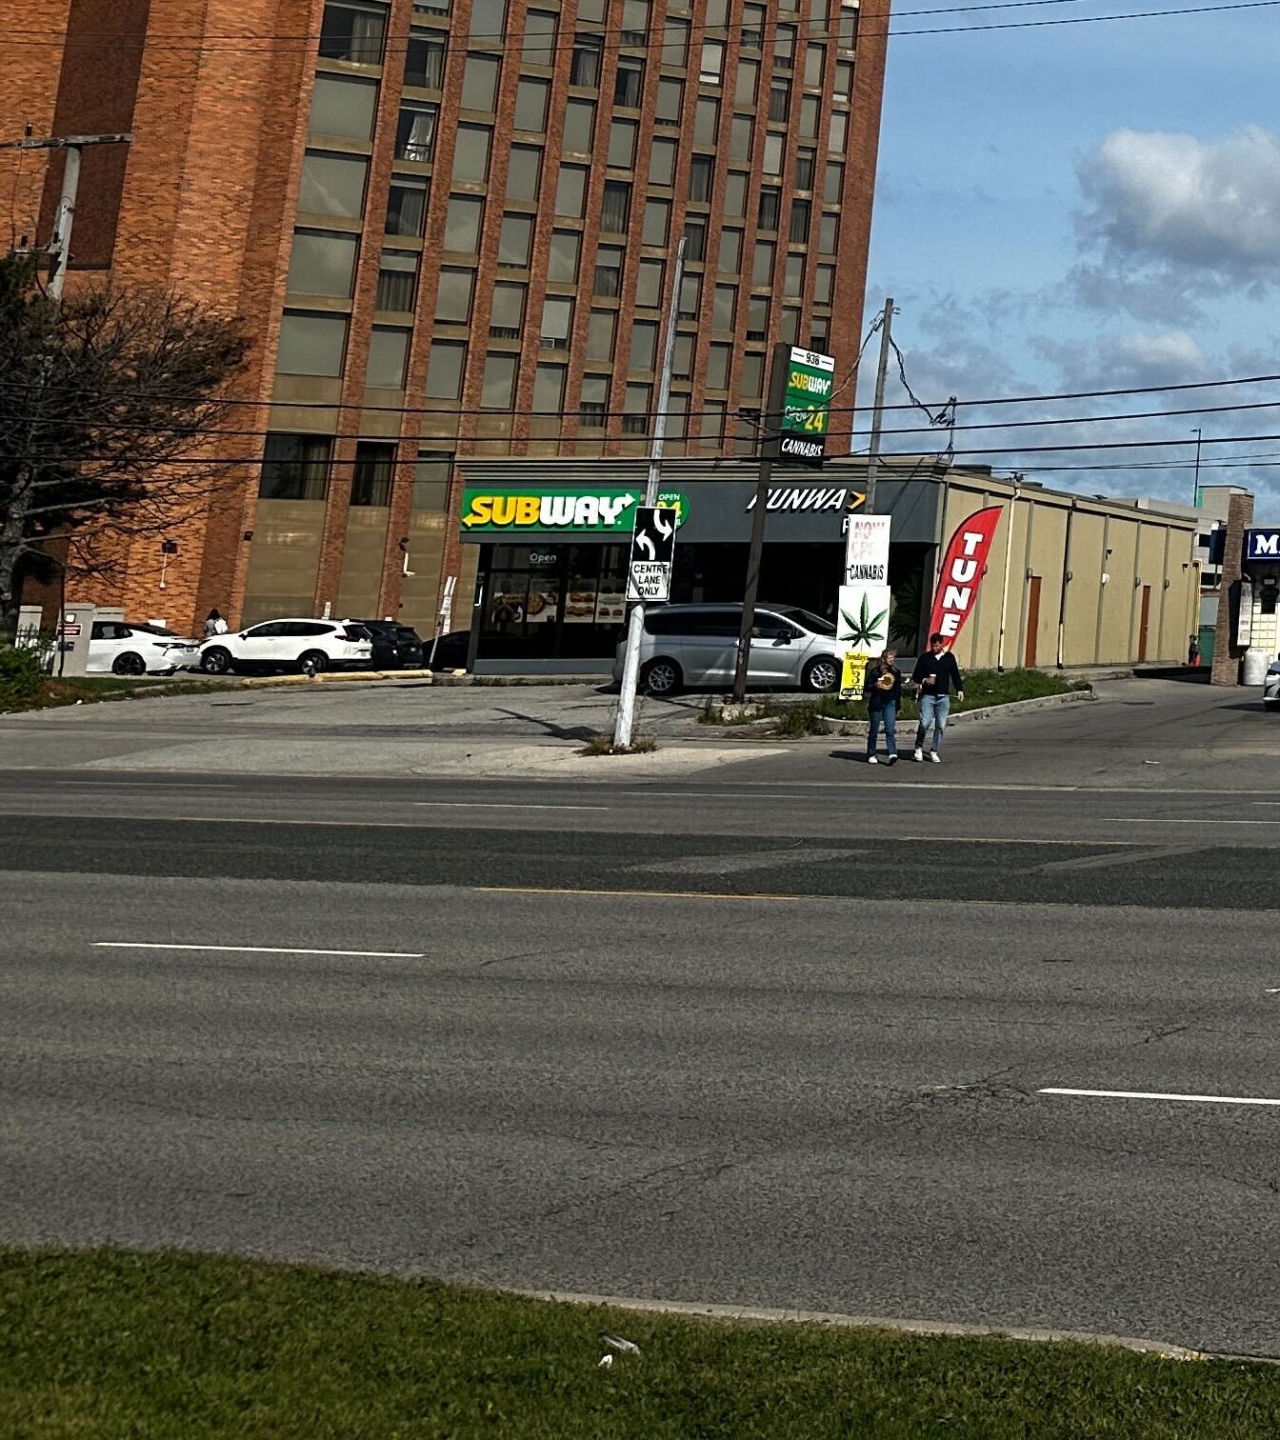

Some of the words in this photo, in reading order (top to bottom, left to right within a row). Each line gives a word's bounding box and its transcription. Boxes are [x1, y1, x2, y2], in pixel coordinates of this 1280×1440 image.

[788, 371, 831, 396] SUBWAY
[804, 404, 828, 433] 24
[781, 438, 823, 457] CANNABIS
[658, 493, 680, 501] OPEN
[462, 493, 636, 527] SUBWAY
[529, 552, 557, 563] Open
[633, 564, 668, 574] CENTRE
[850, 564, 884, 580] CANNABIS
[638, 575, 661, 585] LANE
[939, 531, 984, 637] TUNE
[637, 586, 660, 596] ONLY
